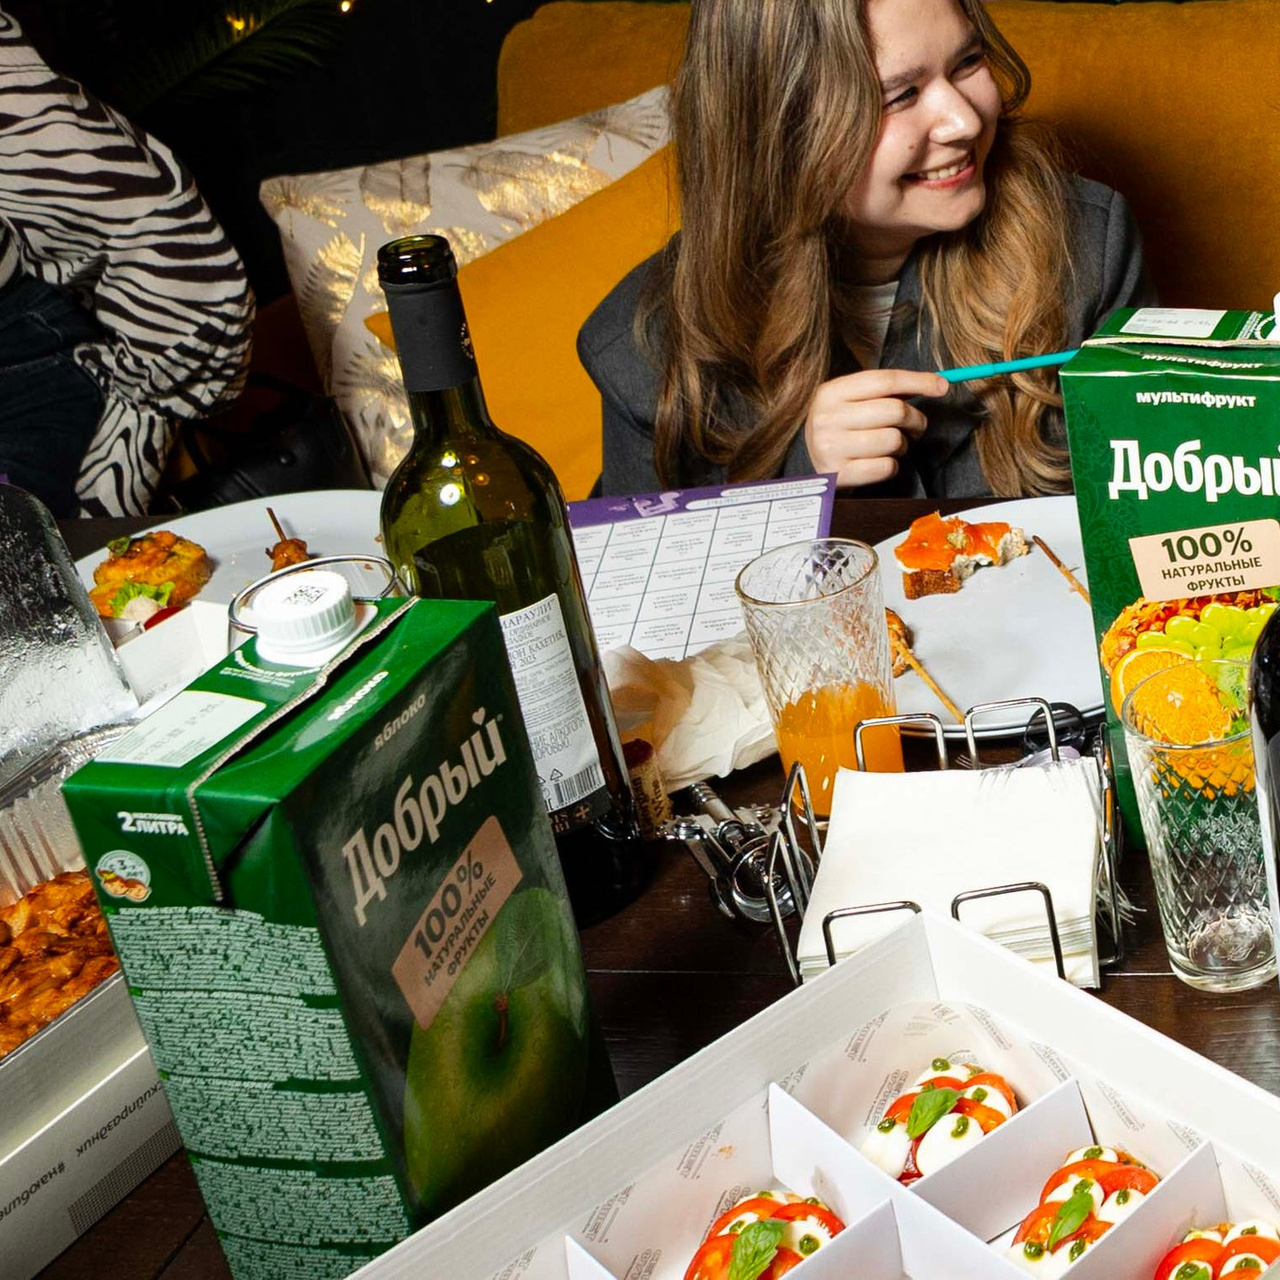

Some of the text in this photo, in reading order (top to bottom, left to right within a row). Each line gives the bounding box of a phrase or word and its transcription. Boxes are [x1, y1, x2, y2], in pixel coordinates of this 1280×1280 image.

[1135, 390, 1256, 409] мультифрукт
[1161, 527, 1253, 563] 100%
[1161, 556, 1263, 580] НАТУРАЛЬНЫЕ
[1187, 575, 1246, 592] ФРУКТЫ
[374, 693, 427, 752] яблоко
[117, 811, 136, 832] 2
[135, 819, 190, 836] ЛИТРА
[341, 707, 507, 927] Добрый
[413, 849, 484, 961] 100%
[424, 873, 497, 987] НАТУРАЛЬНЫЕ
[446, 909, 490, 977] ФРУКТЫ
